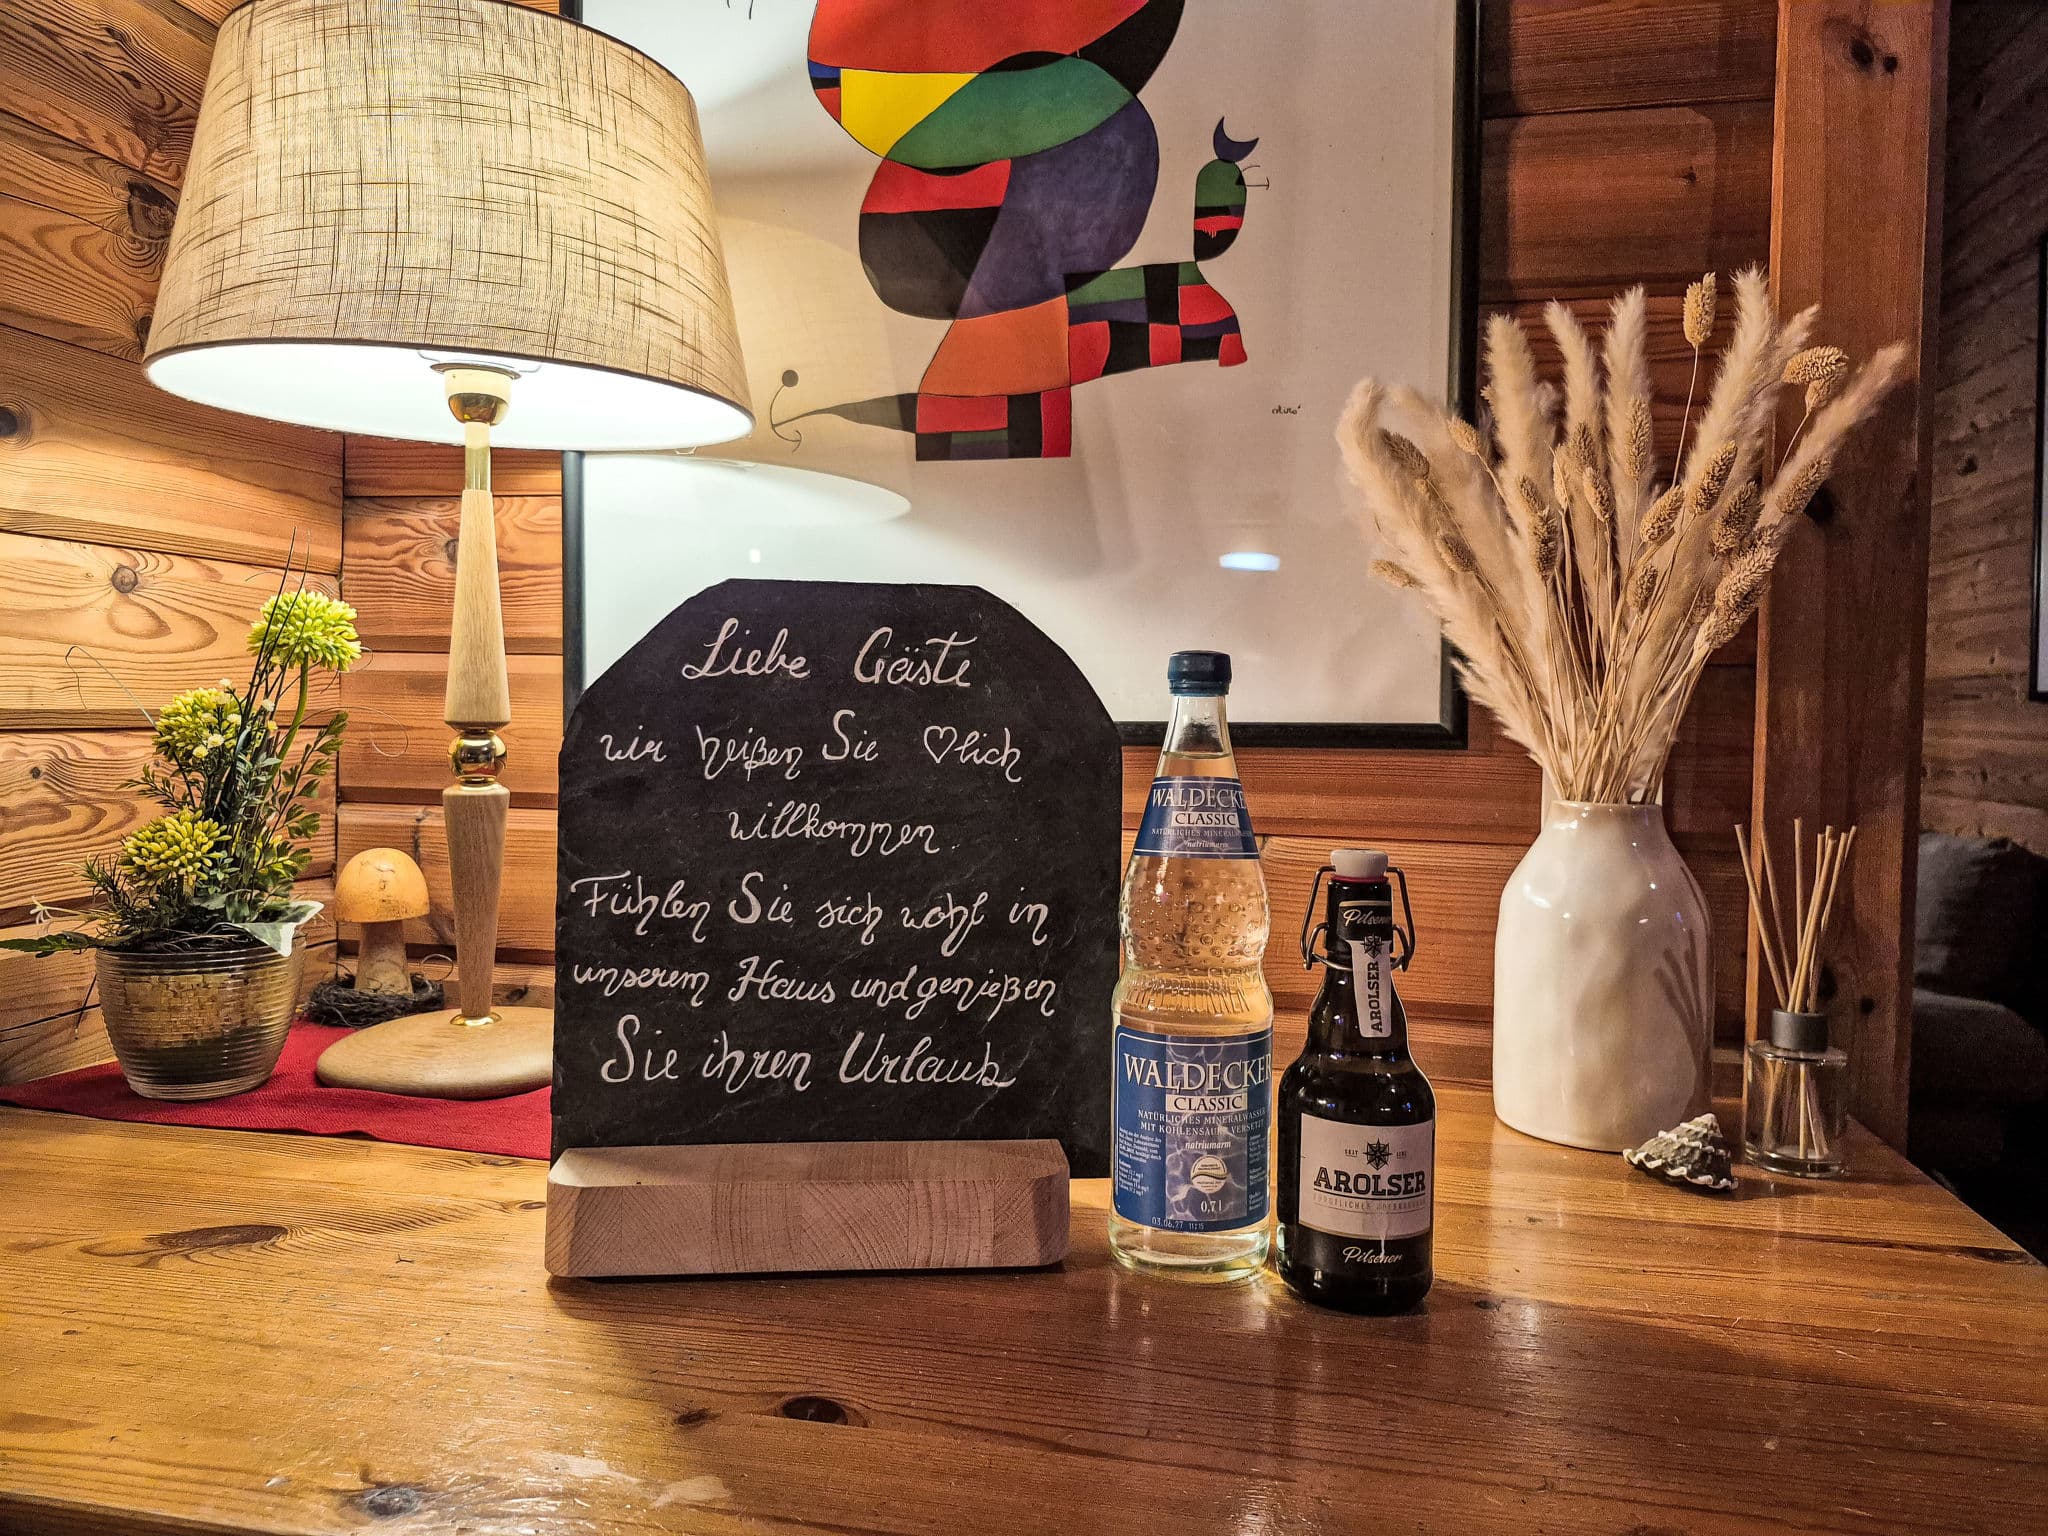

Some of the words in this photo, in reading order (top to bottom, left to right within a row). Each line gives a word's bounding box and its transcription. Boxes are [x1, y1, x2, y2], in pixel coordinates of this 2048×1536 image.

[682, 617, 811, 679] Liebe
[854, 626, 977, 687] Gäste
[600, 725, 667, 762] wir
[696, 725, 803, 782] heißen
[822, 709, 879, 761] Sie
[1175, 812, 1236, 826] CLASSIC
[570, 870, 711, 943] Fühlen
[729, 871, 793, 924] Sie
[816, 891, 883, 945] sich
[901, 891, 989, 957] wohl
[1008, 886, 1049, 946] in
[573, 963, 710, 1007] unserem
[728, 955, 836, 1003] Haus
[850, 964, 918, 1007] und
[905, 968, 1056, 1022] genießen
[1367, 961, 1383, 1033] AROLSER
[601, 1014, 680, 1083] Sie
[702, 1030, 812, 1093] ihren
[838, 1030, 1017, 1087] Urlaub
[1140, 1121, 1156, 1132] MIT
[1174, 1096, 1243, 1111] CLASSIC
[1185, 1140, 1231, 1150] natriumarm
[1314, 1166, 1425, 1196] AROLSER
[1342, 1246, 1403, 1264] Pilsener
